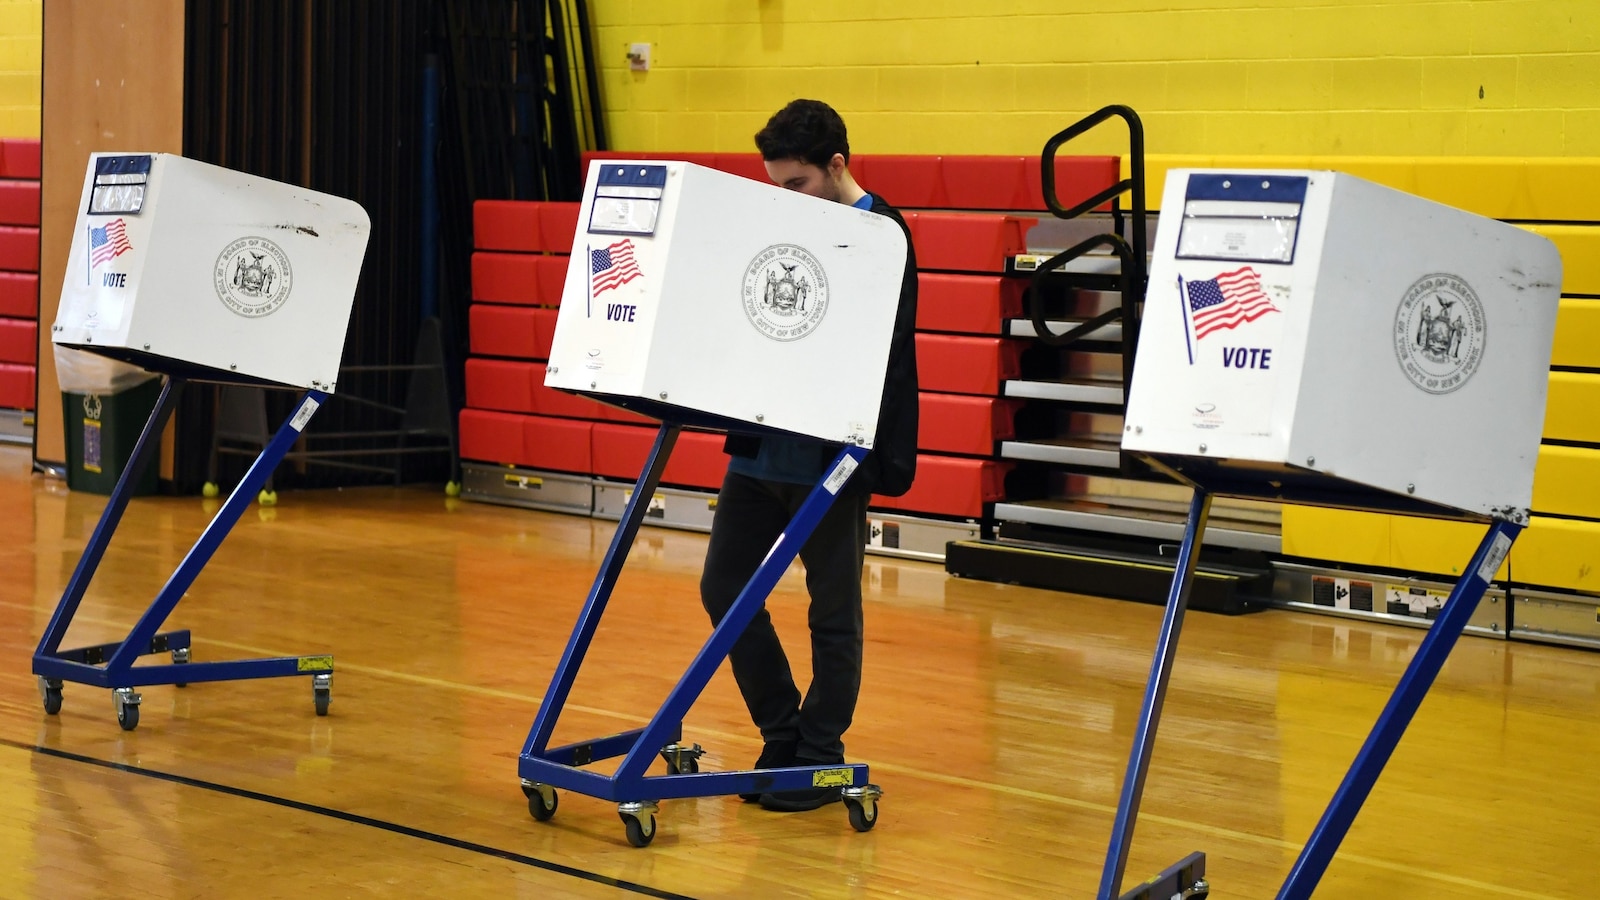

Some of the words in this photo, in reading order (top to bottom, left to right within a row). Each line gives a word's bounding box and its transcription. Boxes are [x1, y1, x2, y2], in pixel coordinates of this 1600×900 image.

[223, 241, 247, 261] BOARD
[261, 241, 289, 276] ELECTIONS
[750, 250, 776, 276] BOARD
[777, 247, 789, 255] OF
[791, 249, 825, 289] ELECTIONS
[103, 272, 127, 288] VOTE
[225, 296, 242, 311] CITY
[254, 303, 272, 314] NEW
[272, 285, 288, 305] YORK
[745, 285, 753, 297] IN
[607, 303, 637, 323] VOTE
[746, 298, 758, 318] THE
[808, 299, 825, 324] YORK
[1404, 279, 1433, 309] BOARD
[1434, 278, 1449, 287] OF
[1450, 280, 1482, 333] ELECTIONS
[756, 317, 776, 334] CITY
[776, 329, 789, 337] OF
[789, 322, 810, 337] NEW
[1223, 347, 1272, 370] VOTE
[1406, 362, 1427, 383] CITY
[1426, 379, 1440, 388] OF
[1440, 372, 1461, 389] NEW
[1461, 346, 1480, 375] YORK
